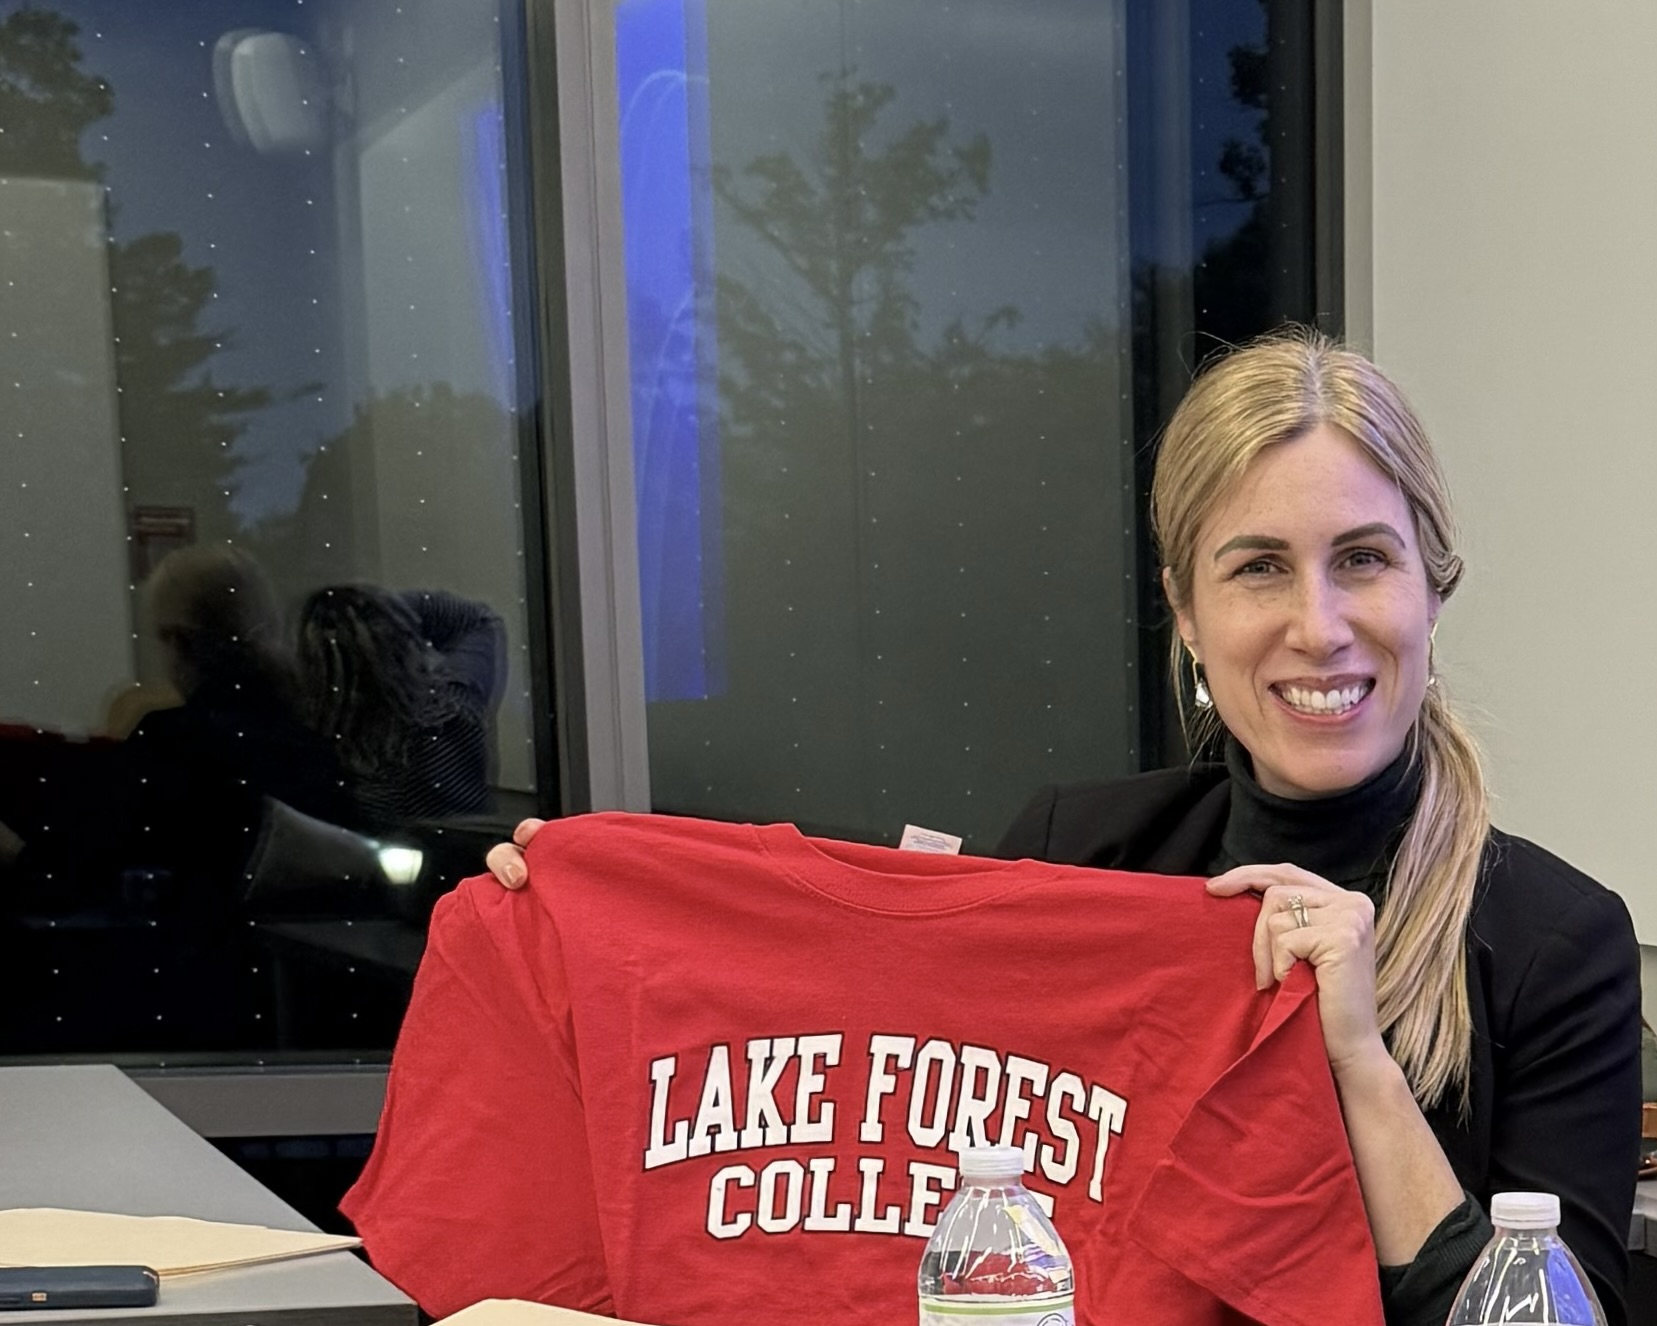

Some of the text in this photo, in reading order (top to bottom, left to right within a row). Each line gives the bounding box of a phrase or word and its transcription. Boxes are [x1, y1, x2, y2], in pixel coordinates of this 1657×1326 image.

[644, 1033, 1128, 1202] LAKE FOREST
[705, 1157, 1055, 1240] COLLE
